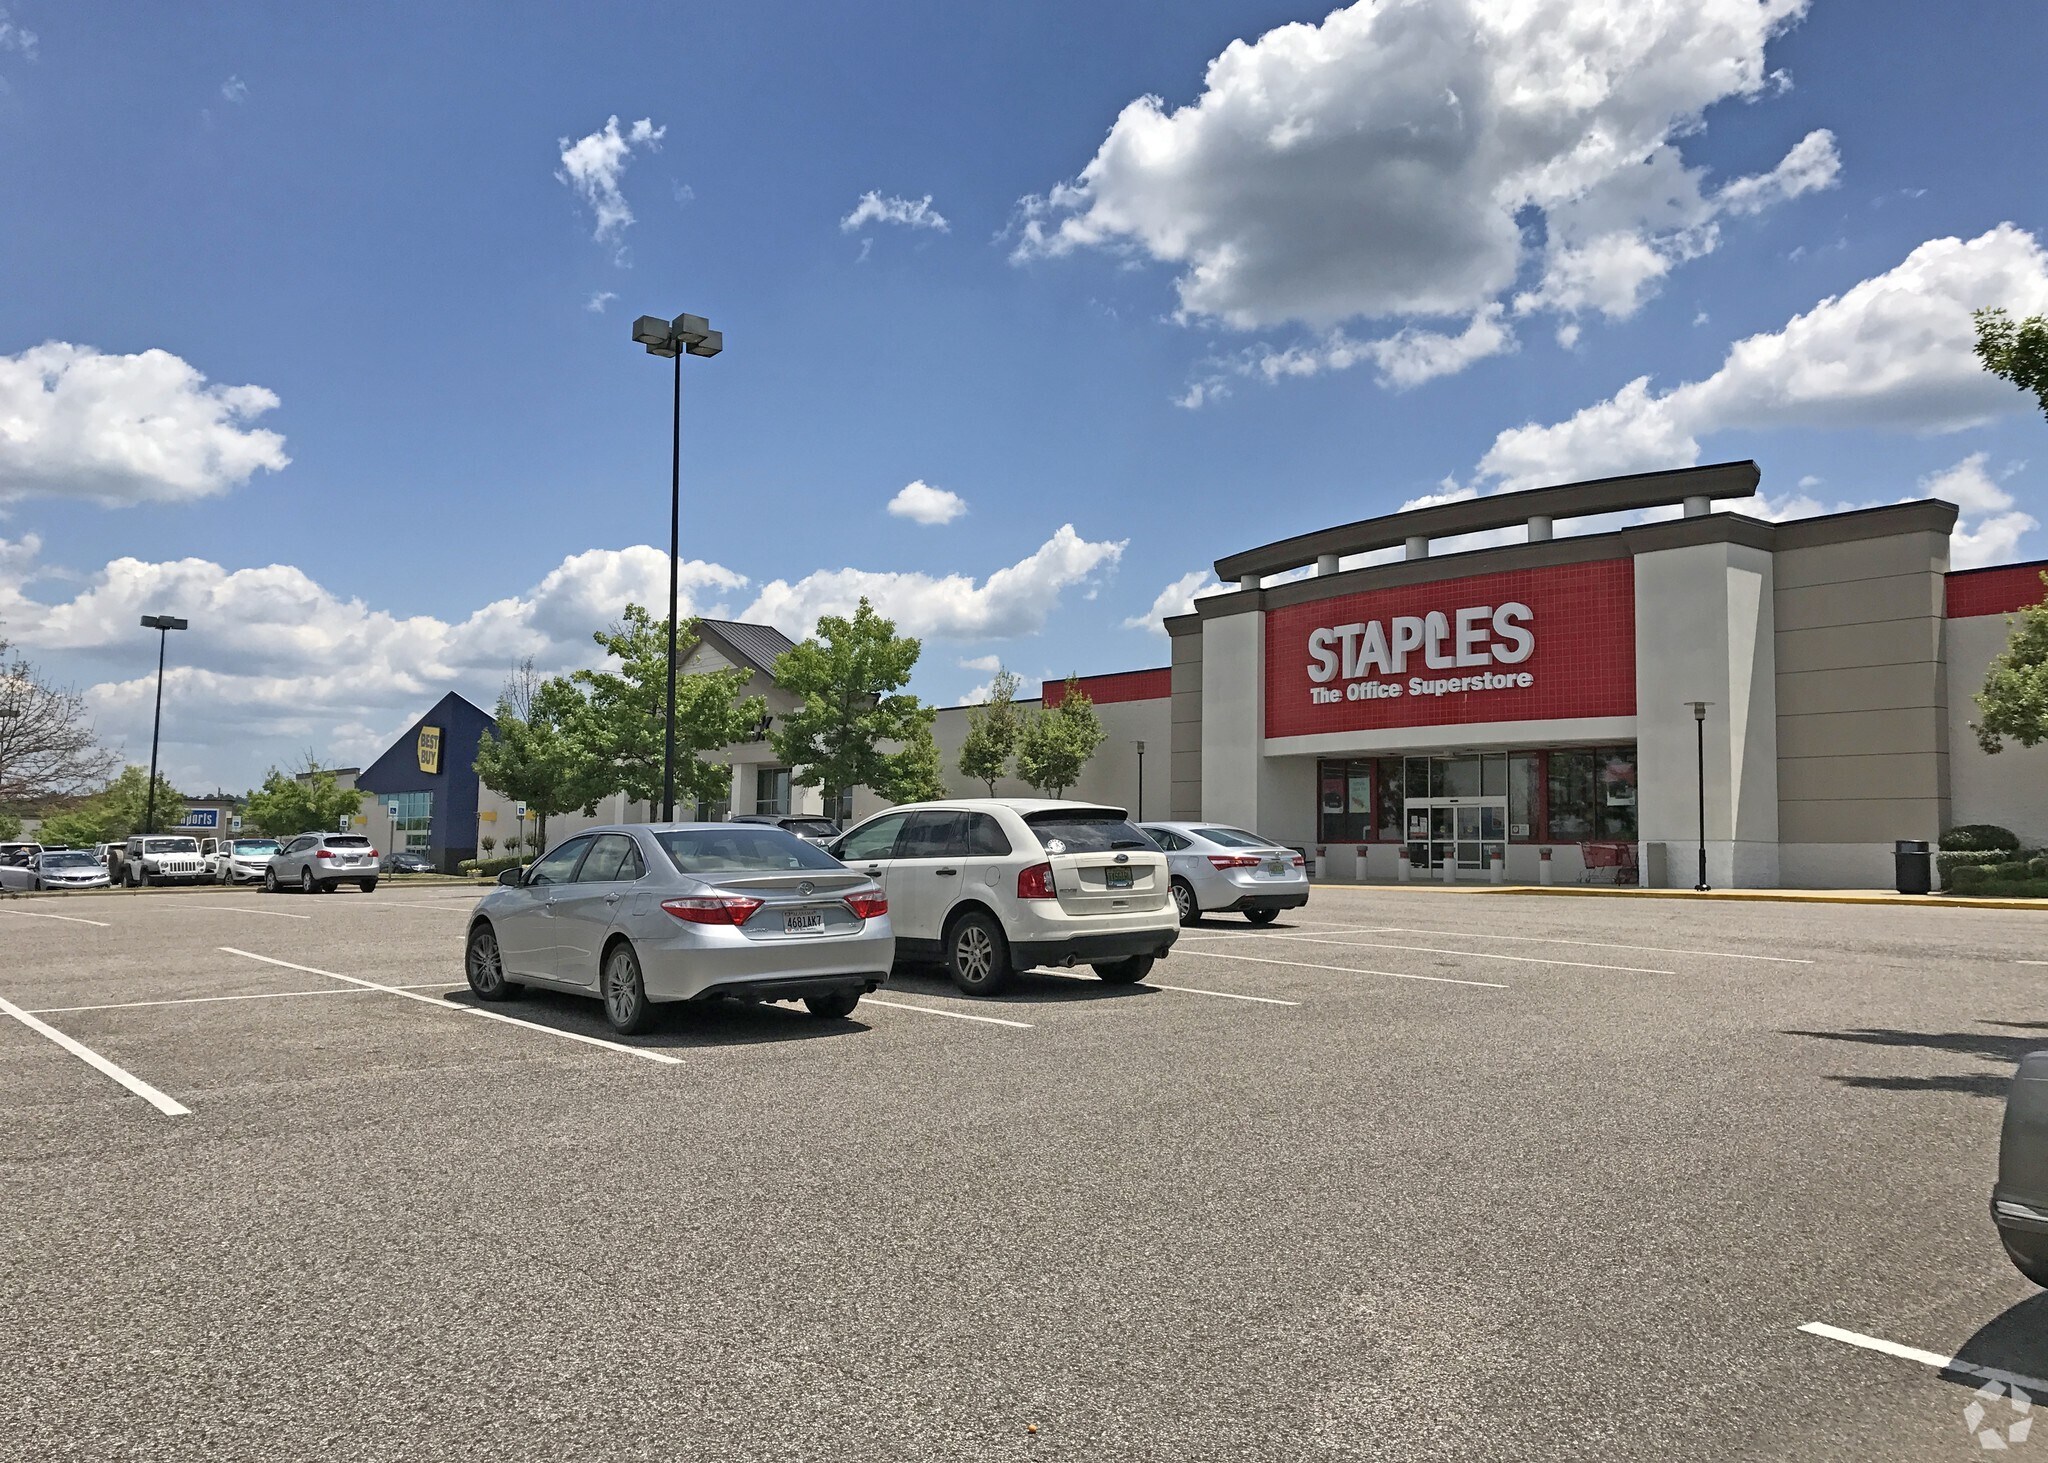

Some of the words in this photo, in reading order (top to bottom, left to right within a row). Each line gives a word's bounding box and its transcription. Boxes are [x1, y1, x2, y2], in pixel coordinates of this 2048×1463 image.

[1307, 602, 1535, 683] STAPLES
[1310, 686, 1342, 704] The
[1347, 681, 1403, 701] Office
[1408, 671, 1534, 697] Superstore
[420, 733, 439, 750] BEST
[420, 750, 437, 766] BUY
